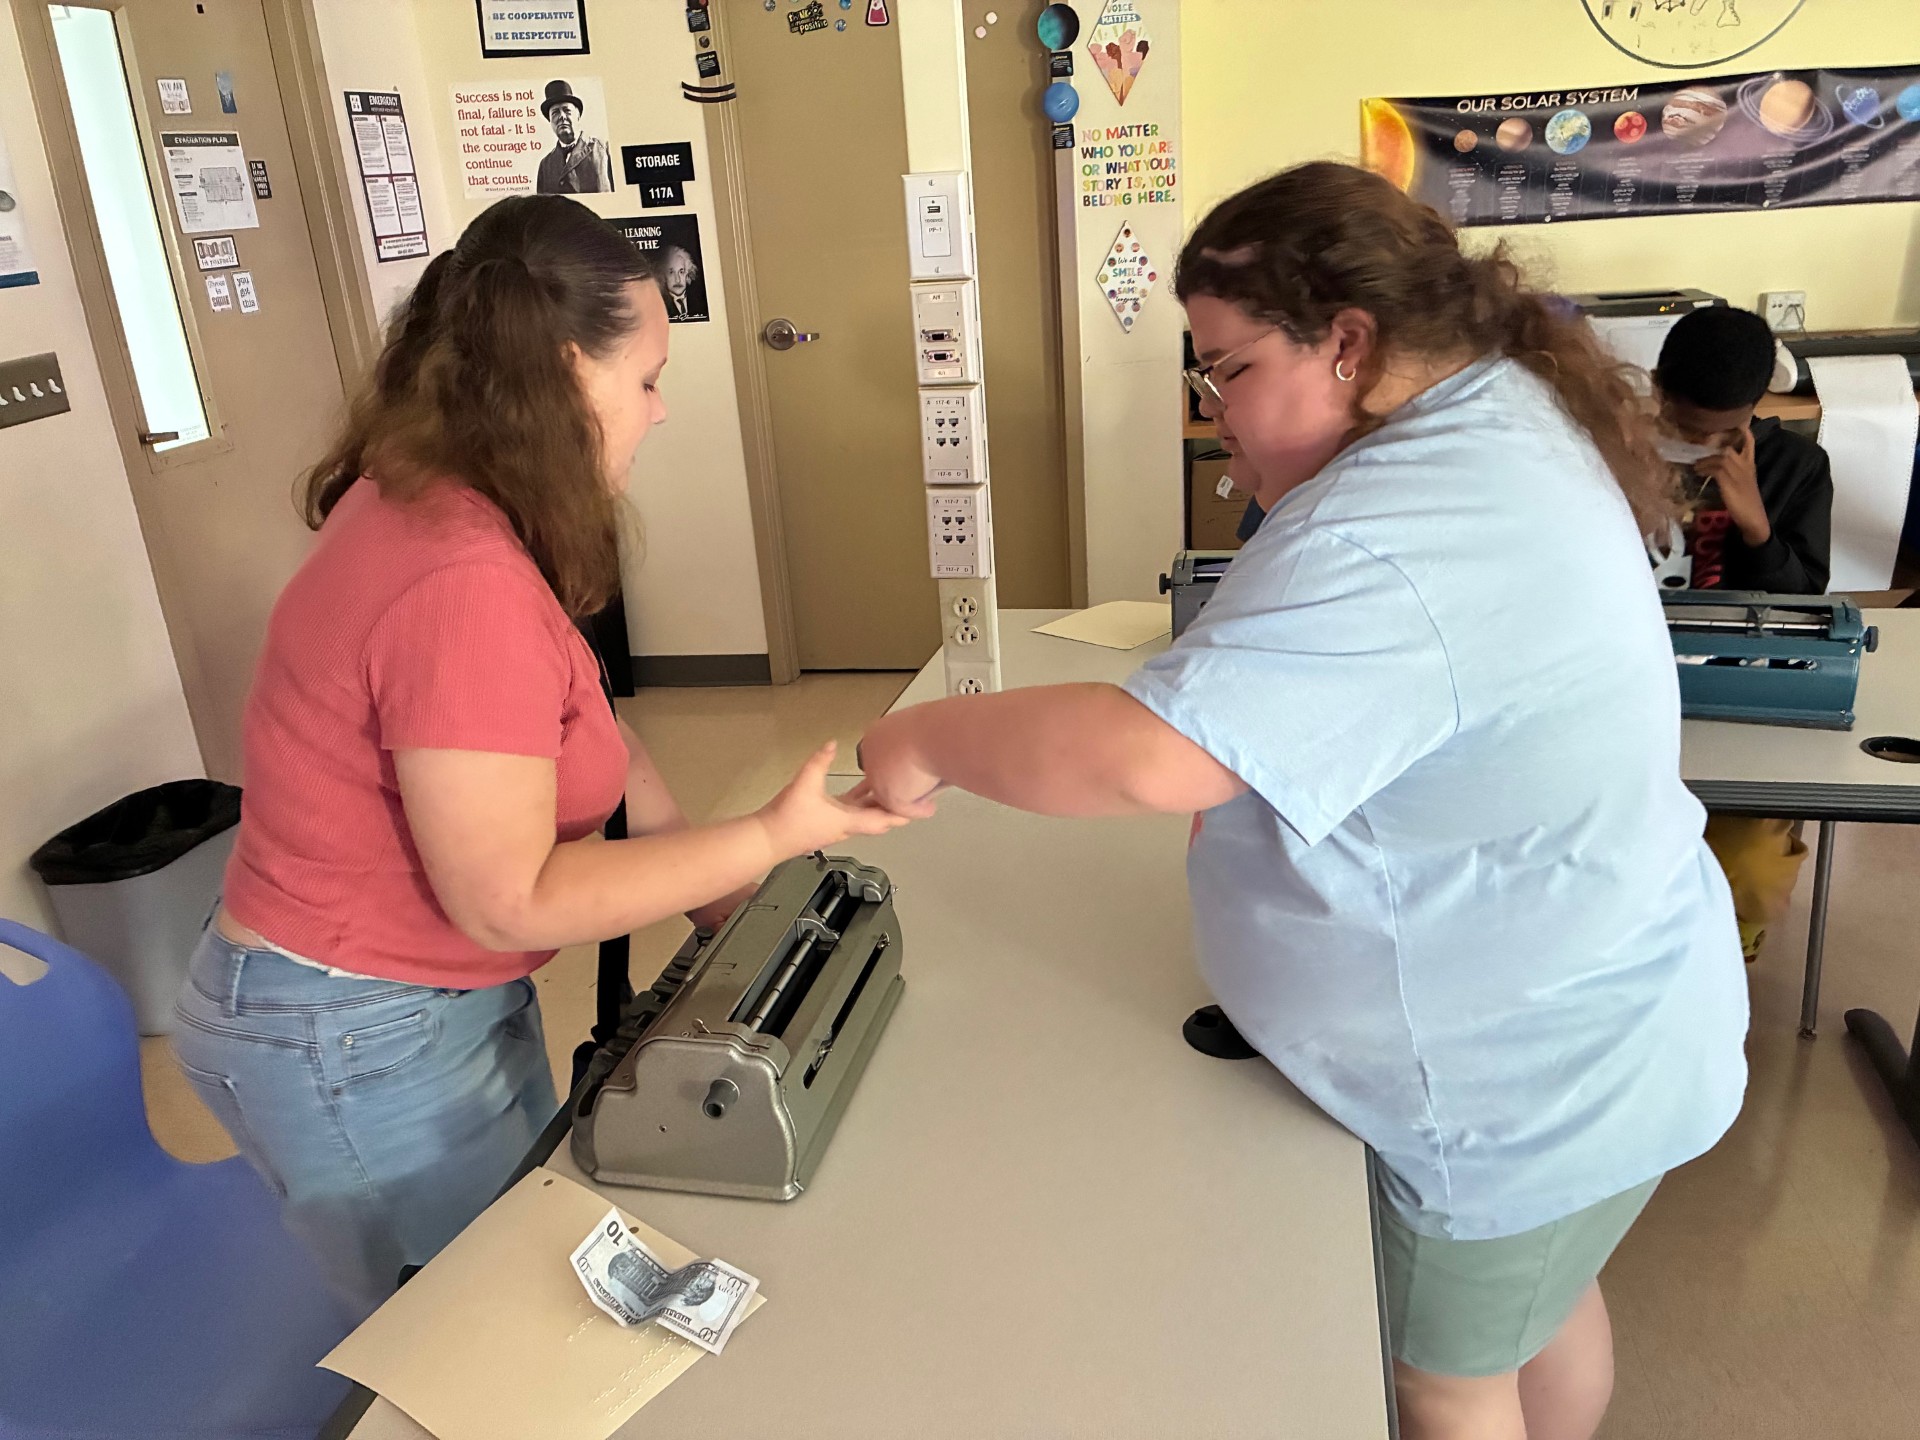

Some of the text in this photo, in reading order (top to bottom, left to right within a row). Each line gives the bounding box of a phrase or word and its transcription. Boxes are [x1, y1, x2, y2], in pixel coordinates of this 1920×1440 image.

[1107, 3, 1133, 13] VOICE
[492, 11, 574, 20] BE COOPERATIVE
[1101, 14, 1137, 24] MATTERS
[495, 31, 576, 40] BE RESPECTFUL
[455, 89, 534, 104] Success is not
[1456, 87, 1639, 114] OUR SOLAR SYSTEM
[457, 106, 536, 121] final, failure is
[460, 126, 479, 137] not
[481, 124, 505, 136] fatal
[526, 123, 536, 134] is
[1082, 128, 1101, 142] NO
[1106, 123, 1159, 141] MATTER
[463, 140, 542, 154] the courage to
[1081, 140, 1174, 159] WHO YOU ARE
[465, 158, 513, 170] continue
[635, 154, 681, 169] STORAGE
[1082, 157, 1176, 177] OR WHAT YOUR
[467, 173, 532, 186] that counts.
[1082, 173, 1176, 192] STORY IS, YOU
[648, 186, 674, 200] 117A
[1083, 189, 1176, 207] BELONG HERE.
[624, 226, 662, 238] LEARNING
[635, 239, 660, 250] THE
[1112, 266, 1143, 278] SMILE
[606, 1220, 624, 1246] 10
